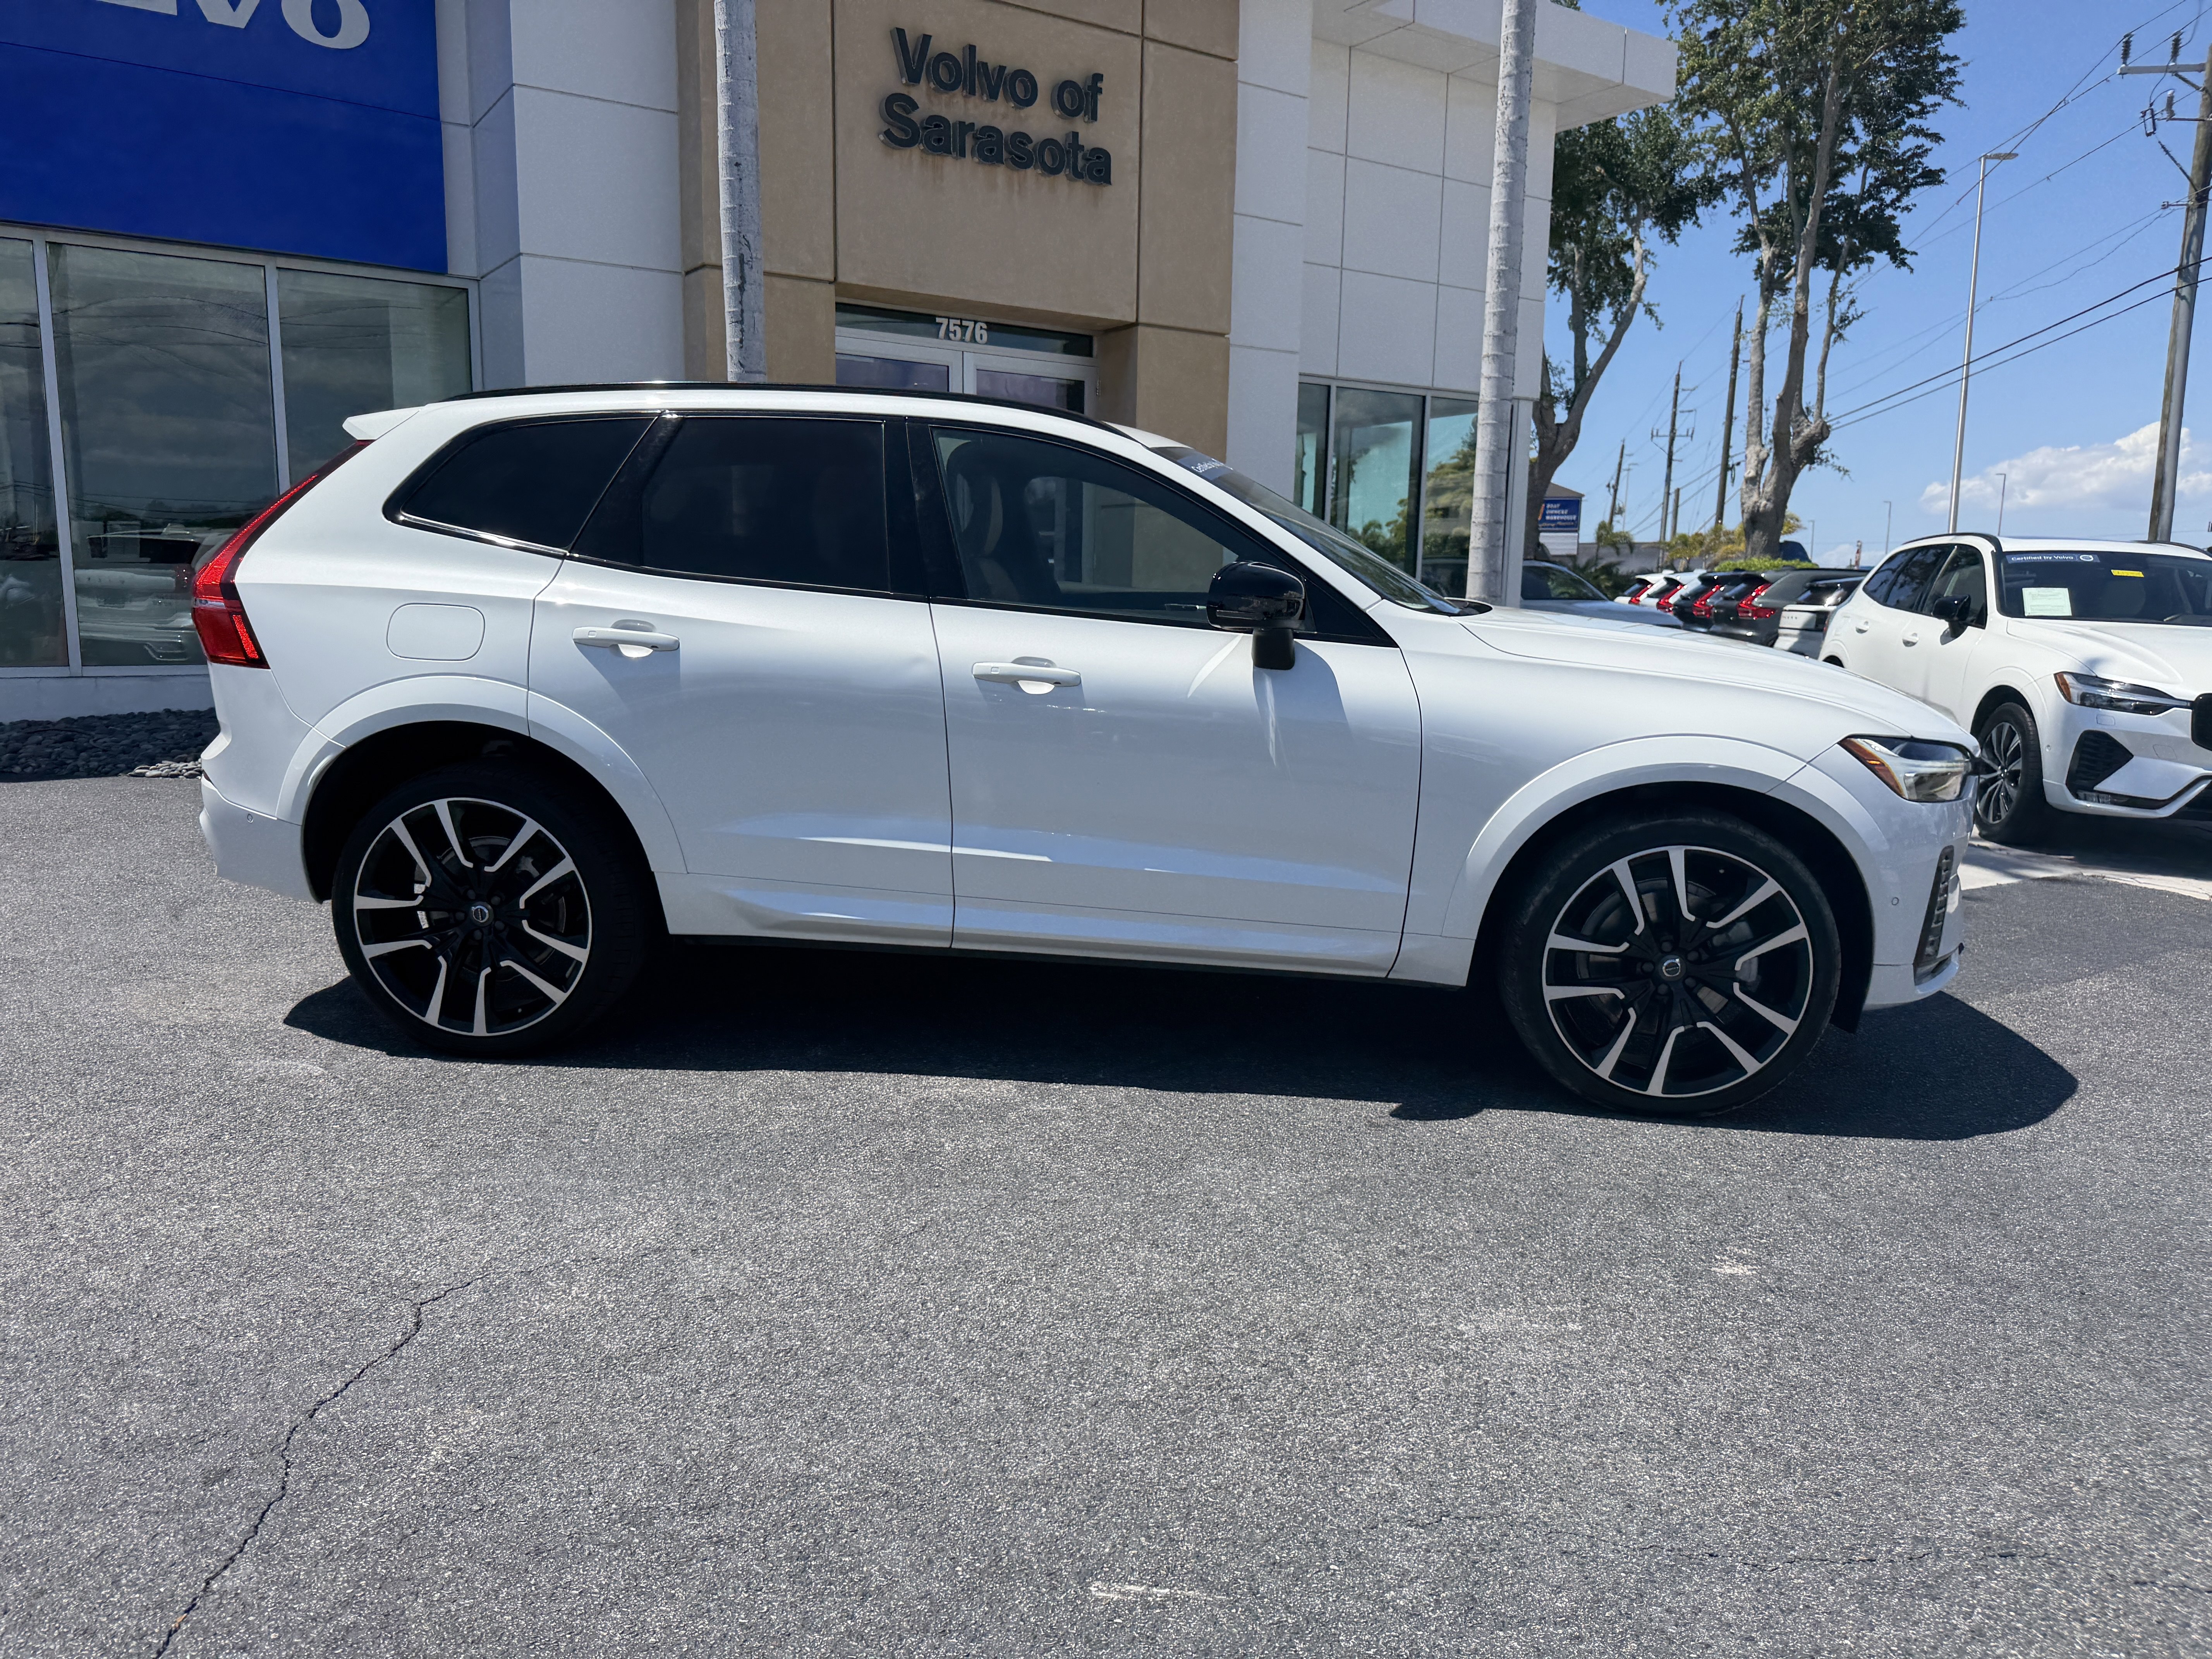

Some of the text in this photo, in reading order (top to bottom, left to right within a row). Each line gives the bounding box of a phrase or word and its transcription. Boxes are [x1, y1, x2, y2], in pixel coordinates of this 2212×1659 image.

[890, 27, 1104, 123] Volvo of
[878, 93, 1112, 186] Sarasota
[936, 317, 988, 344] 7576
